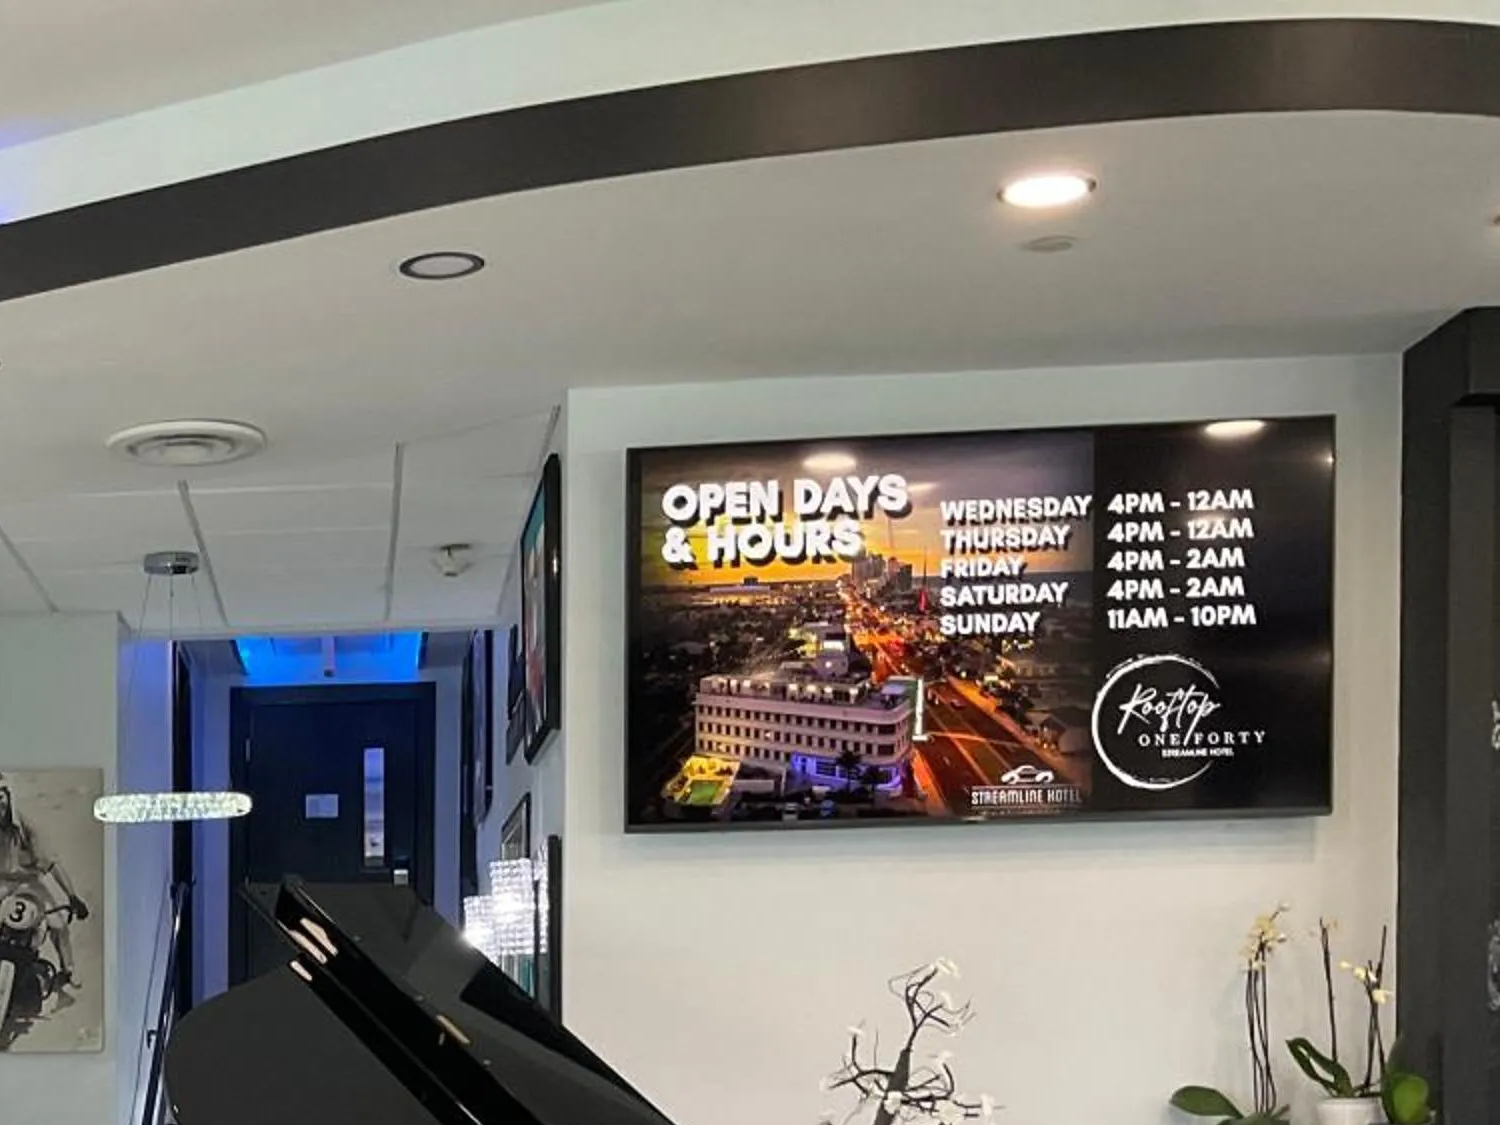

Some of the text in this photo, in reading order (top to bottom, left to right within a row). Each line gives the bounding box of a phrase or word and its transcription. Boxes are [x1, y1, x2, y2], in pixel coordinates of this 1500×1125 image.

[662, 474, 909, 522] OPEN DAYS
[940, 495, 1092, 522] WEDNESDAY
[1107, 492, 1164, 514] 4PM
[1187, 489, 1254, 512] 12AM
[662, 519, 863, 565] & HOURS
[940, 525, 1071, 551] THURSDAY
[1107, 521, 1164, 543] 4PM
[1187, 518, 1254, 540] 12AM
[940, 555, 1025, 579] FRIDAY
[1107, 550, 1164, 572] 4PM
[1186, 548, 1245, 570] 2AM
[940, 582, 1069, 608] SATURDAY
[1107, 579, 1164, 601] 4PM
[1186, 576, 1245, 598] 2AM
[940, 611, 1041, 636] SUNDAY
[1107, 608, 1169, 630] 11AM
[1191, 604, 1257, 627] 10PM
[1116, 683, 1221, 747] Rooftop
[1138, 730, 1266, 747] ONE FORTY
[971, 787, 1082, 805] STREAMLINE HOTEL
[8, 901, 26, 923] 3
